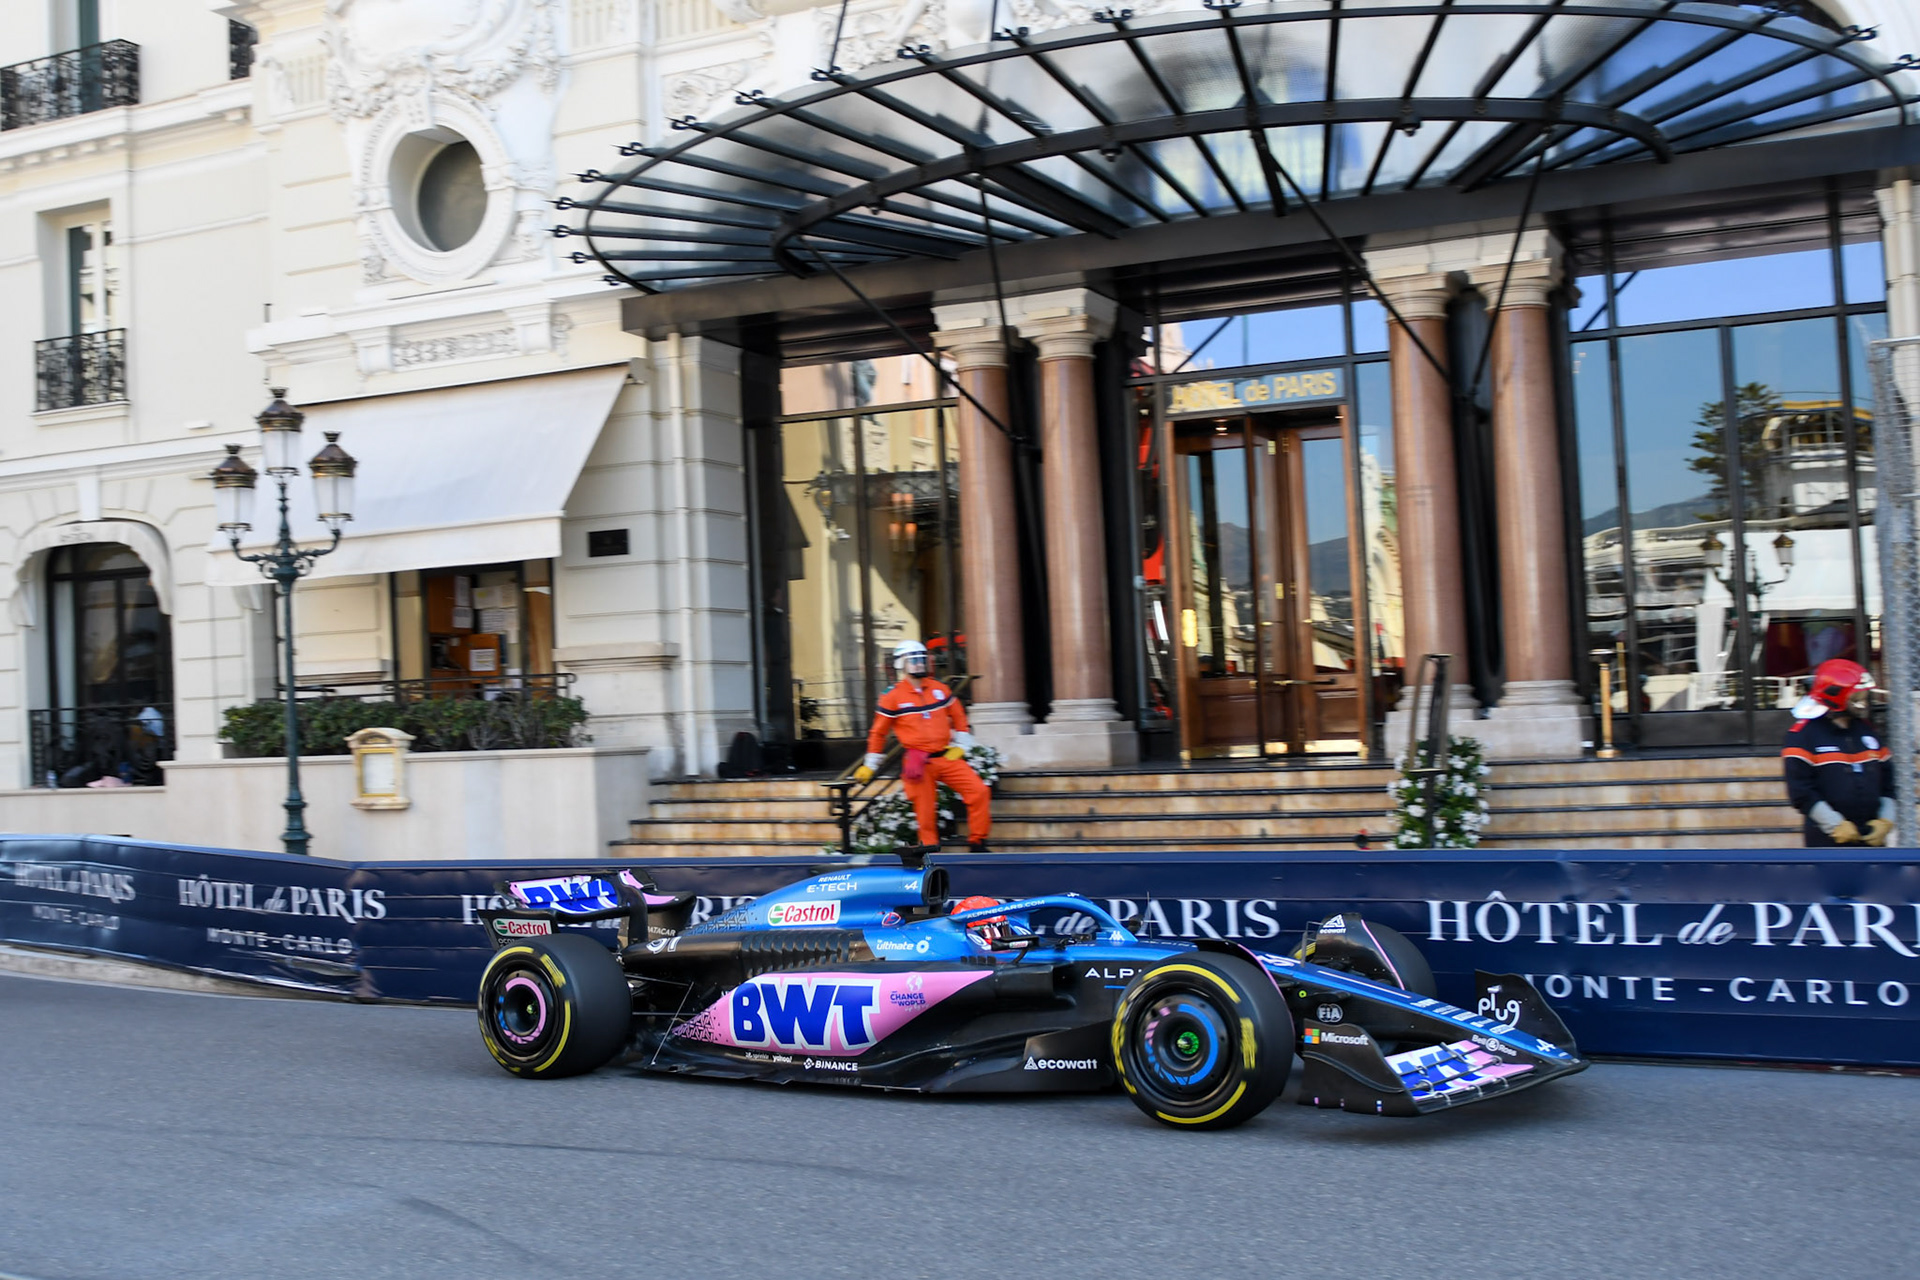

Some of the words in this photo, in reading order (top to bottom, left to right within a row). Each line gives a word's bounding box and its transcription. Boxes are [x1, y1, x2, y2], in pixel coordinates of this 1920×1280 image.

[1244, 379, 1270, 402] de
[1274, 371, 1337, 399] PARIS
[80, 870, 137, 904] PARIS
[806, 882, 857, 893] E-TECH
[818, 874, 851, 882] RENAULT
[178, 874, 263, 910] HÔTEL
[263, 886, 289, 912] de
[290, 885, 387, 925] PARIS
[784, 903, 835, 923] Castrol
[967, 900, 1046, 919] ALPINECARS.COM
[1053, 912, 1098, 936] de
[1106, 898, 1280, 940] PARIS
[1425, 890, 1663, 946] HÔTEL
[1676, 903, 1738, 946] de
[508, 921, 549, 936] Castrol
[876, 940, 914, 950] ultimate
[890, 993, 924, 1001] CHANGE
[1478, 984, 1520, 1028] plug
[730, 980, 877, 1048] BWT
[1321, 1032, 1369, 1046] Microsoft
[1471, 1034, 1486, 1046] Bell
[1498, 1044, 1517, 1057] Ross
[815, 1060, 858, 1072] BINANCE
[1038, 1059, 1098, 1070] ecowatt
